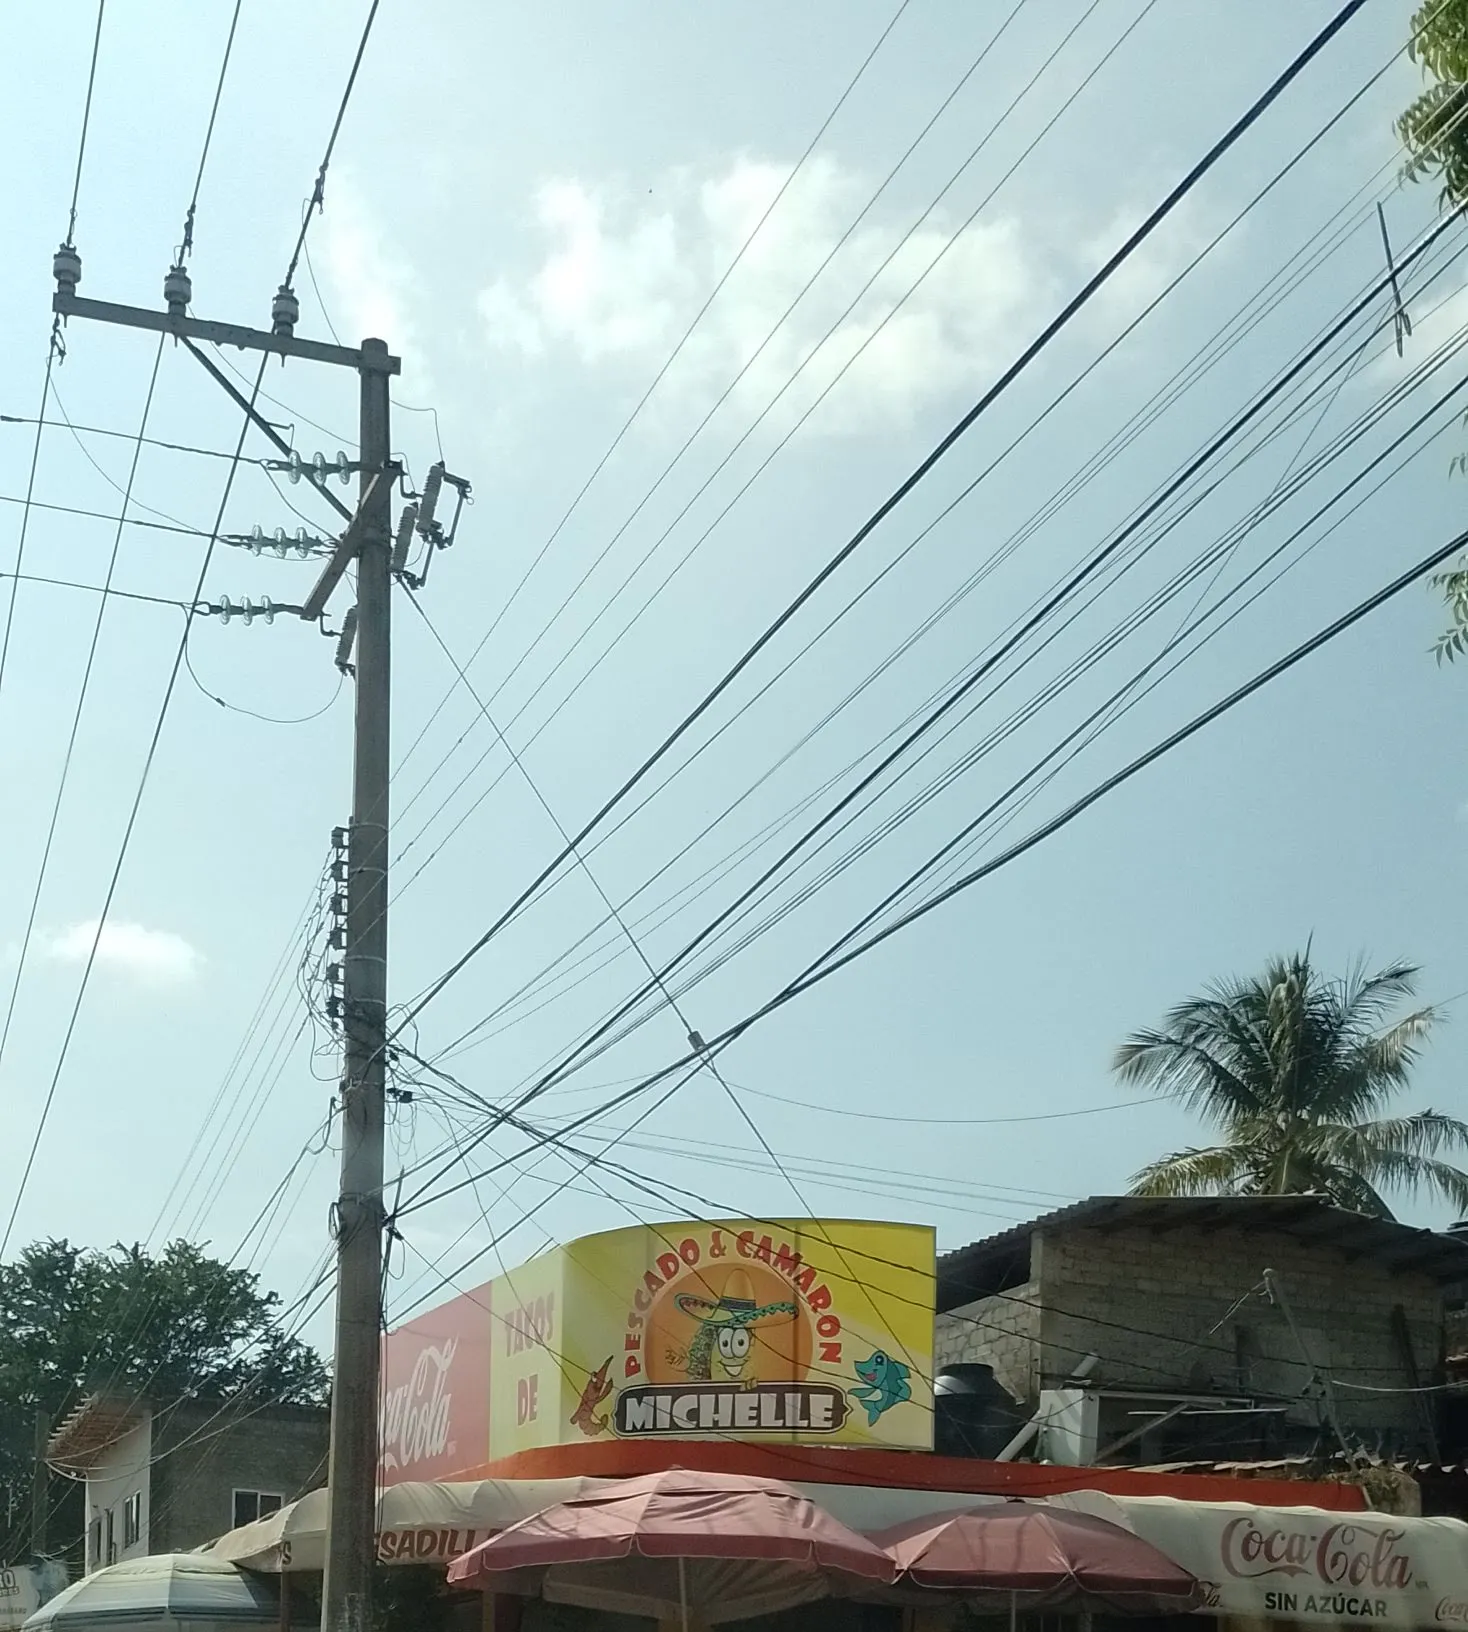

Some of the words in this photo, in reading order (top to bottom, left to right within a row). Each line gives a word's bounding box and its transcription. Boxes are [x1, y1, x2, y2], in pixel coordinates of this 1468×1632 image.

[504, 1291, 556, 1358] TACOS
[624, 1239, 700, 1377] PESCADO
[709, 1230, 727, 1258] &
[736, 1231, 842, 1364] CAMARON
[516, 1373, 540, 1426] DE
[625, 1393, 834, 1431] MICHELLE
[374, 1529, 500, 1560] SADILL
[1220, 1517, 1413, 1589] Coca-Cola
[1264, 1592, 1298, 1612] SIN
[1304, 1593, 1388, 1618] AZÚCAR
